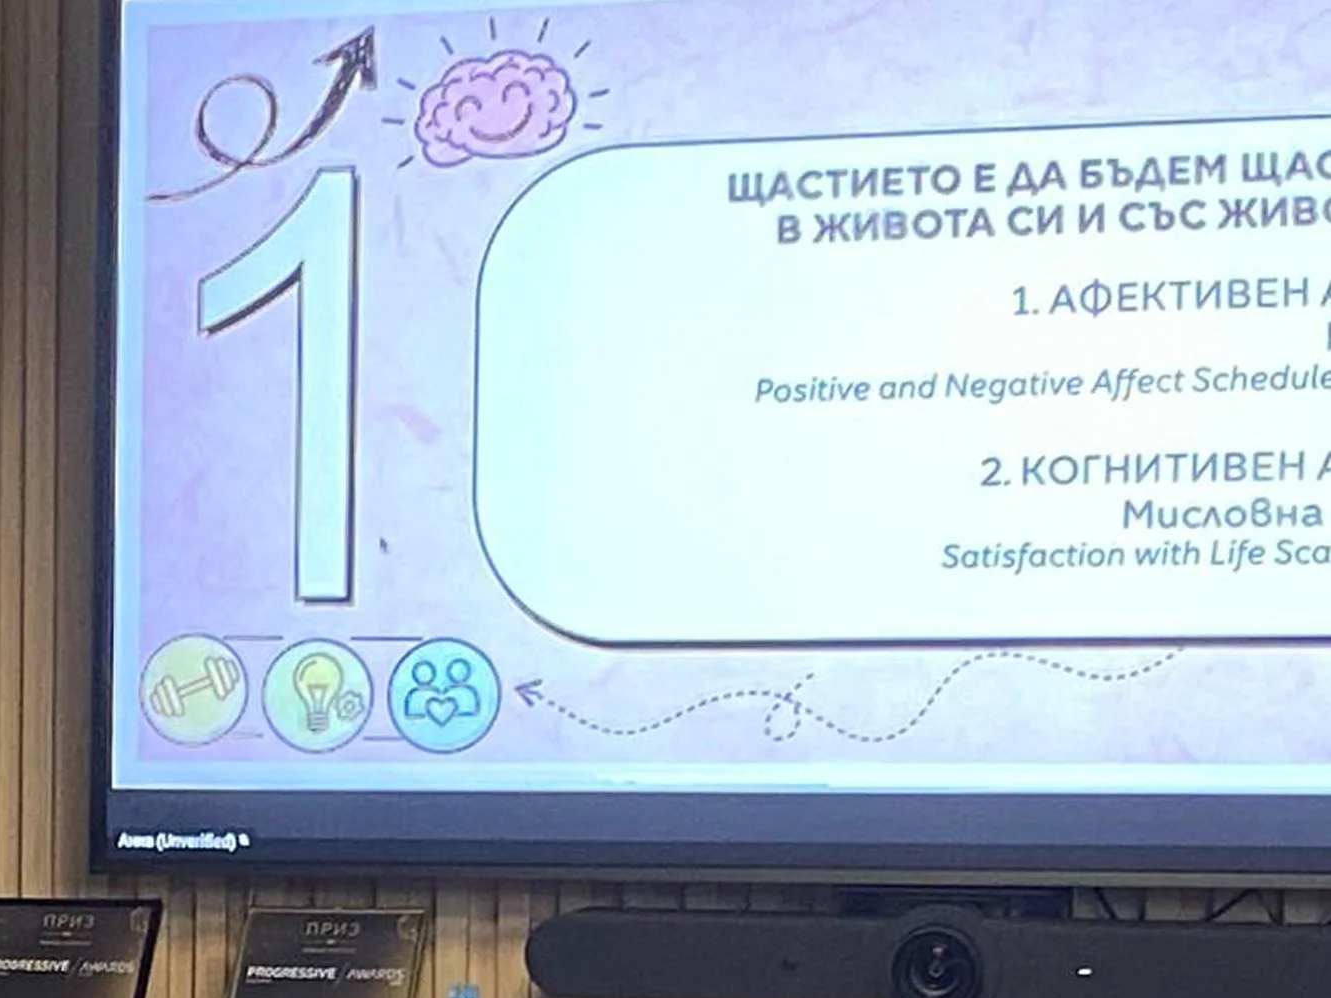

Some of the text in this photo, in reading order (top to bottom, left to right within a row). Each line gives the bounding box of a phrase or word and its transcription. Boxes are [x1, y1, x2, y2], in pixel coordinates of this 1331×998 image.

[727, 163, 962, 208] ЩАСТИЕТО
[974, 163, 997, 194] Е
[1005, 160, 1068, 198] ДА
[1079, 153, 1227, 193] БЪДЕМ
[777, 195, 1331, 245] В ЖИВОТА СИ И СЪС ЖИВ
[1012, 285, 1041, 316] 1.
[1048, 276, 1309, 319] АФЕКТИВЕН
[198, 166, 361, 606] 1
[755, 363, 1331, 405] Positive and Negative Affect Schedule
[980, 457, 1012, 487] 2.
[1021, 449, 1306, 487] КОГНИТИВЕН
[1122, 496, 1324, 530] Мисловна
[941, 542, 1126, 576] Satisfaction
[1134, 539, 1201, 567] with
[1210, 538, 1267, 574] Life
[305, 921, 361, 937] ПРИЗ
[78, 960, 137, 975] AWARDS
[246, 965, 407, 981] PROGRESSIVE AWARDS
